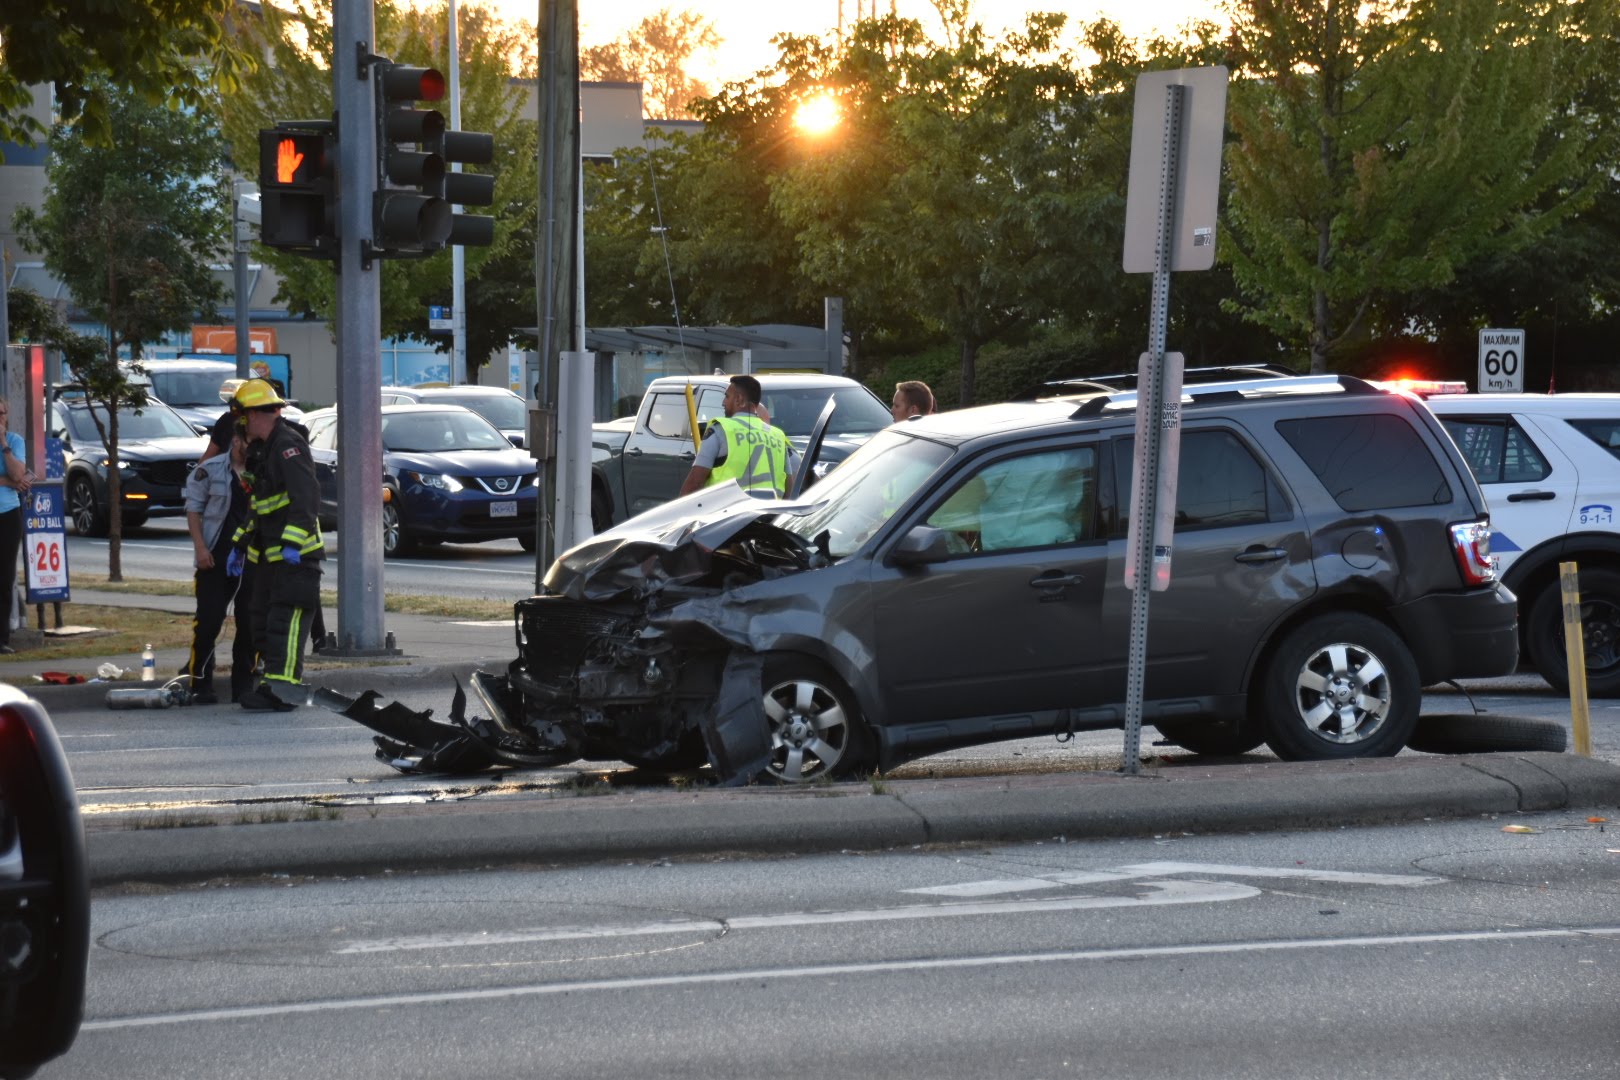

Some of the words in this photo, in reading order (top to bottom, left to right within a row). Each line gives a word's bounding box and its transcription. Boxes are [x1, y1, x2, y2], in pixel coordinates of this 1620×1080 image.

[1483, 335, 1520, 345] MAXIMUM
[1484, 349, 1518, 376] 60
[1488, 379, 1513, 390] km/h
[735, 431, 783, 449] POLICE
[27, 517, 46, 529] GOLD
[47, 516, 62, 528] BALL
[1579, 514, 1613, 525] 9-1-1
[36, 541, 60, 572] 26
